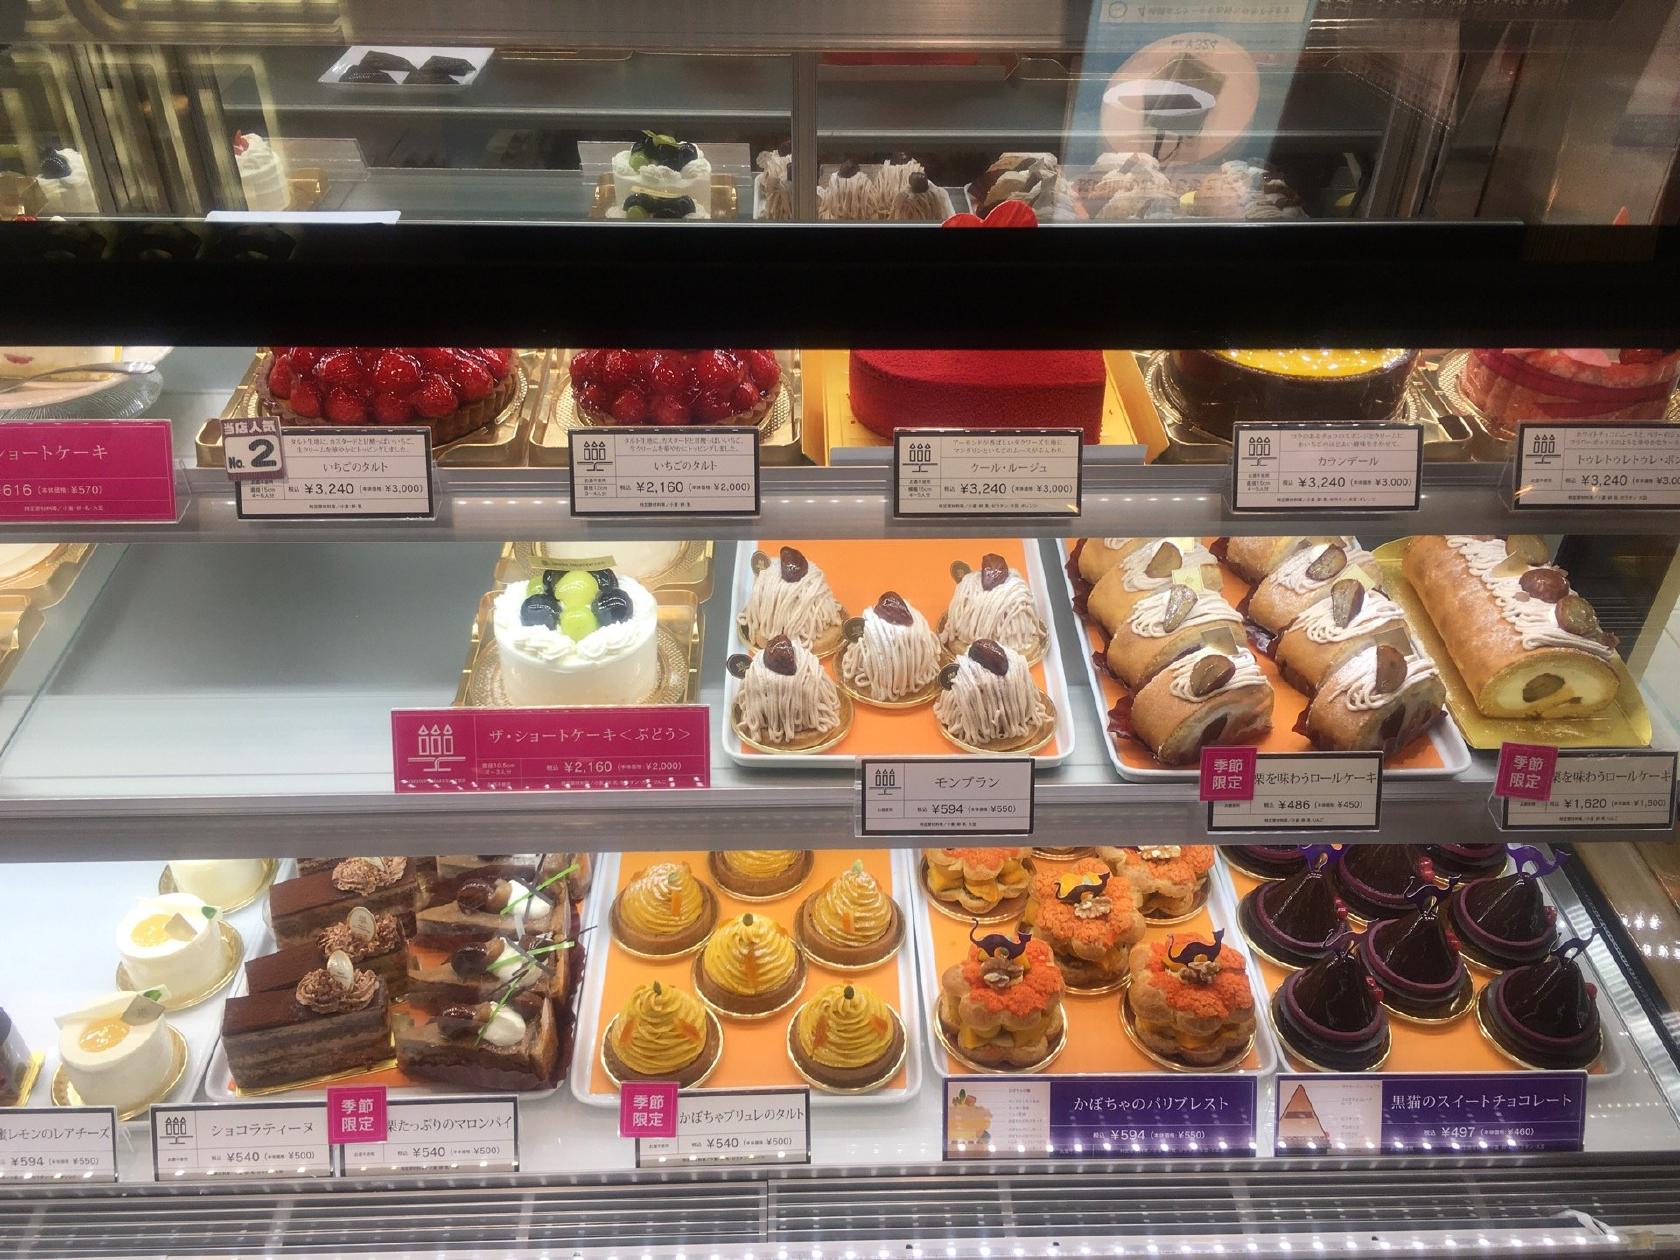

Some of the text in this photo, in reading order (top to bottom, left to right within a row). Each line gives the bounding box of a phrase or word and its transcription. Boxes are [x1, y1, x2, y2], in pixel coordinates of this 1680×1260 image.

[223, 420, 276, 434] 当店人気
[228, 438, 278, 469] No. 2
[323, 461, 389, 473] いちごのタルト
[654, 461, 719, 472] いちごのタルト
[1318, 456, 1379, 466] カランデール
[1297, 477, 1346, 489] ¥3,240
[1375, 478, 1412, 487] ¥3,000)
[1581, 474, 1628, 487] ¥3,240
[0, 484, 32, 496] 616
[304, 483, 354, 495] ¥3,240
[385, 485, 423, 493] ¥3,000)
[636, 481, 684, 494] ¥2,160
[713, 483, 751, 491] ¥2,000)
[960, 483, 1007, 494] ¥3,240
[1036, 485, 1073, 493] ¥3,000)
[489, 727, 691, 744] ザ・ショートケーキ＜ぶどう＞
[563, 761, 613, 773] ¥2,160
[1213, 758, 1244, 772] 季節
[1512, 754, 1544, 771] 季節
[934, 776, 1001, 788] モンブラン
[1211, 775, 1243, 790] 限定
[1508, 772, 1542, 790] 限定
[931, 804, 964, 814] ¥594
[990, 805, 1016, 813] ¥550)
[1278, 800, 1311, 810] ¥486
[1563, 798, 1607, 809] ¥1,620
[341, 1098, 375, 1115] 季節
[633, 1094, 664, 1110] 季節
[1073, 1096, 1230, 1112] かぼちゃのパリブレスト
[1390, 1094, 1573, 1111] 黒猫のスイートチョコレート
[632, 1112, 664, 1127] 限定
[679, 1108, 804, 1125] かぼちゃブリュレのタルト
[211, 1122, 313, 1137] ショコラティーヌ
[341, 1116, 375, 1132] 限定
[1110, 1129, 1146, 1141] ¥594
[1441, 1126, 1476, 1138] ¥497
[706, 1137, 740, 1149] ¥540
[766, 1137, 793, 1146] ¥500)
[226, 1151, 261, 1163] ¥540
[288, 1151, 315, 1160] ¥500)
[412, 1146, 446, 1158] ¥540
[473, 1146, 501, 1156] ¥500)
[11, 1157, 44, 1167] ¥594
[72, 1158, 99, 1166] ¥550)
